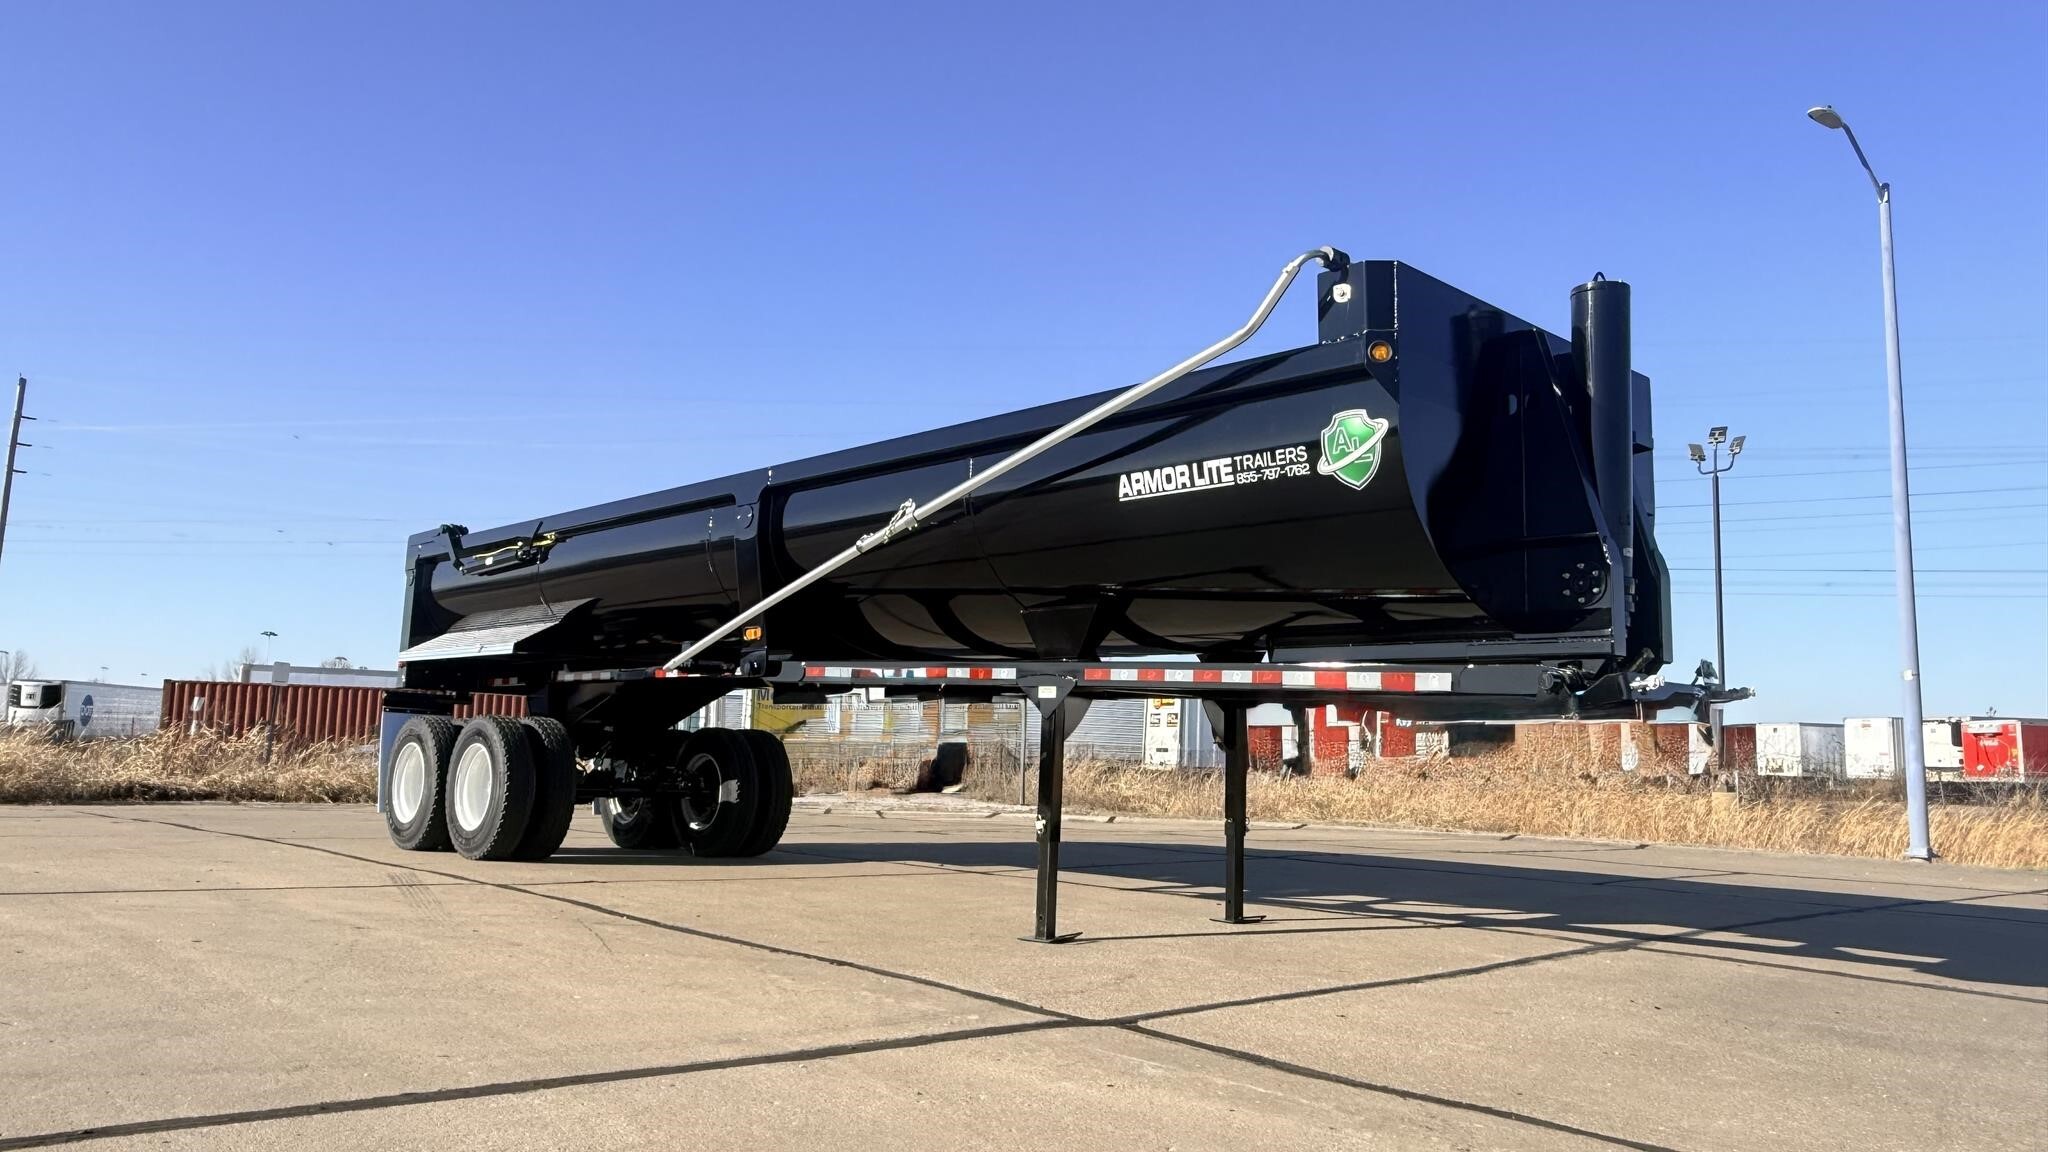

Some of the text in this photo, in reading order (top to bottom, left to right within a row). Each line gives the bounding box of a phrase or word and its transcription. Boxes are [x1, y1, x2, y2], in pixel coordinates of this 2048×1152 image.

[1234, 445, 1308, 471] TRAILERS
[1119, 457, 1234, 498] ARMOR LITE
[1236, 462, 1310, 485] 855-797-1762
